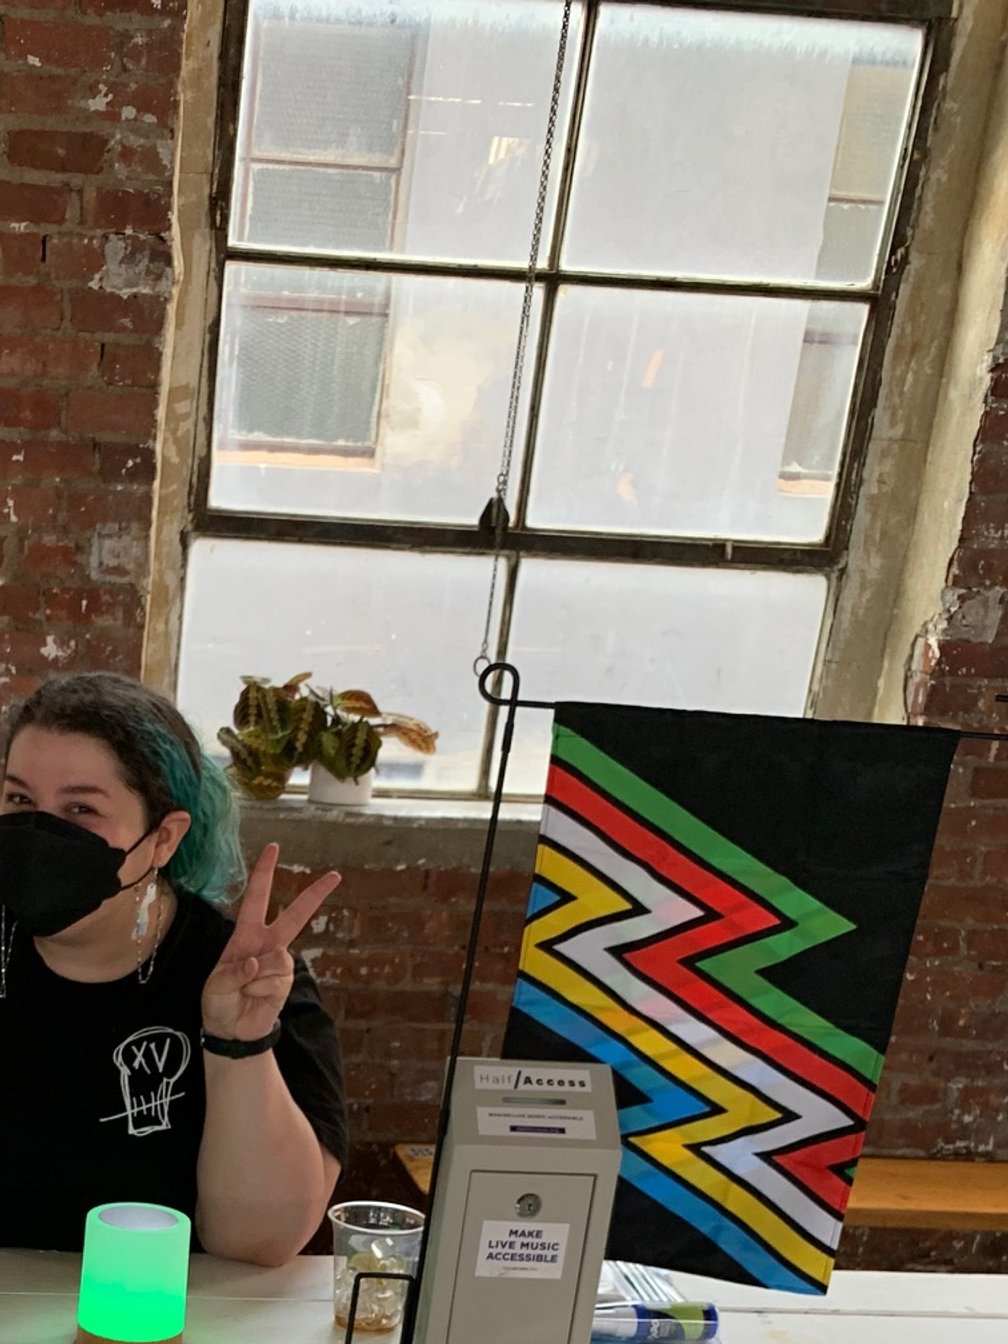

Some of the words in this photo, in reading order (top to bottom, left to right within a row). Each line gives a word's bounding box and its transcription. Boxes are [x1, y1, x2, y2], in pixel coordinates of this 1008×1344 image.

[508, 1229, 543, 1239] MAKE
[488, 1240, 516, 1250] LIVE
[520, 1241, 560, 1252] MUSIC
[486, 1251, 559, 1263] ACCESSIBLE
